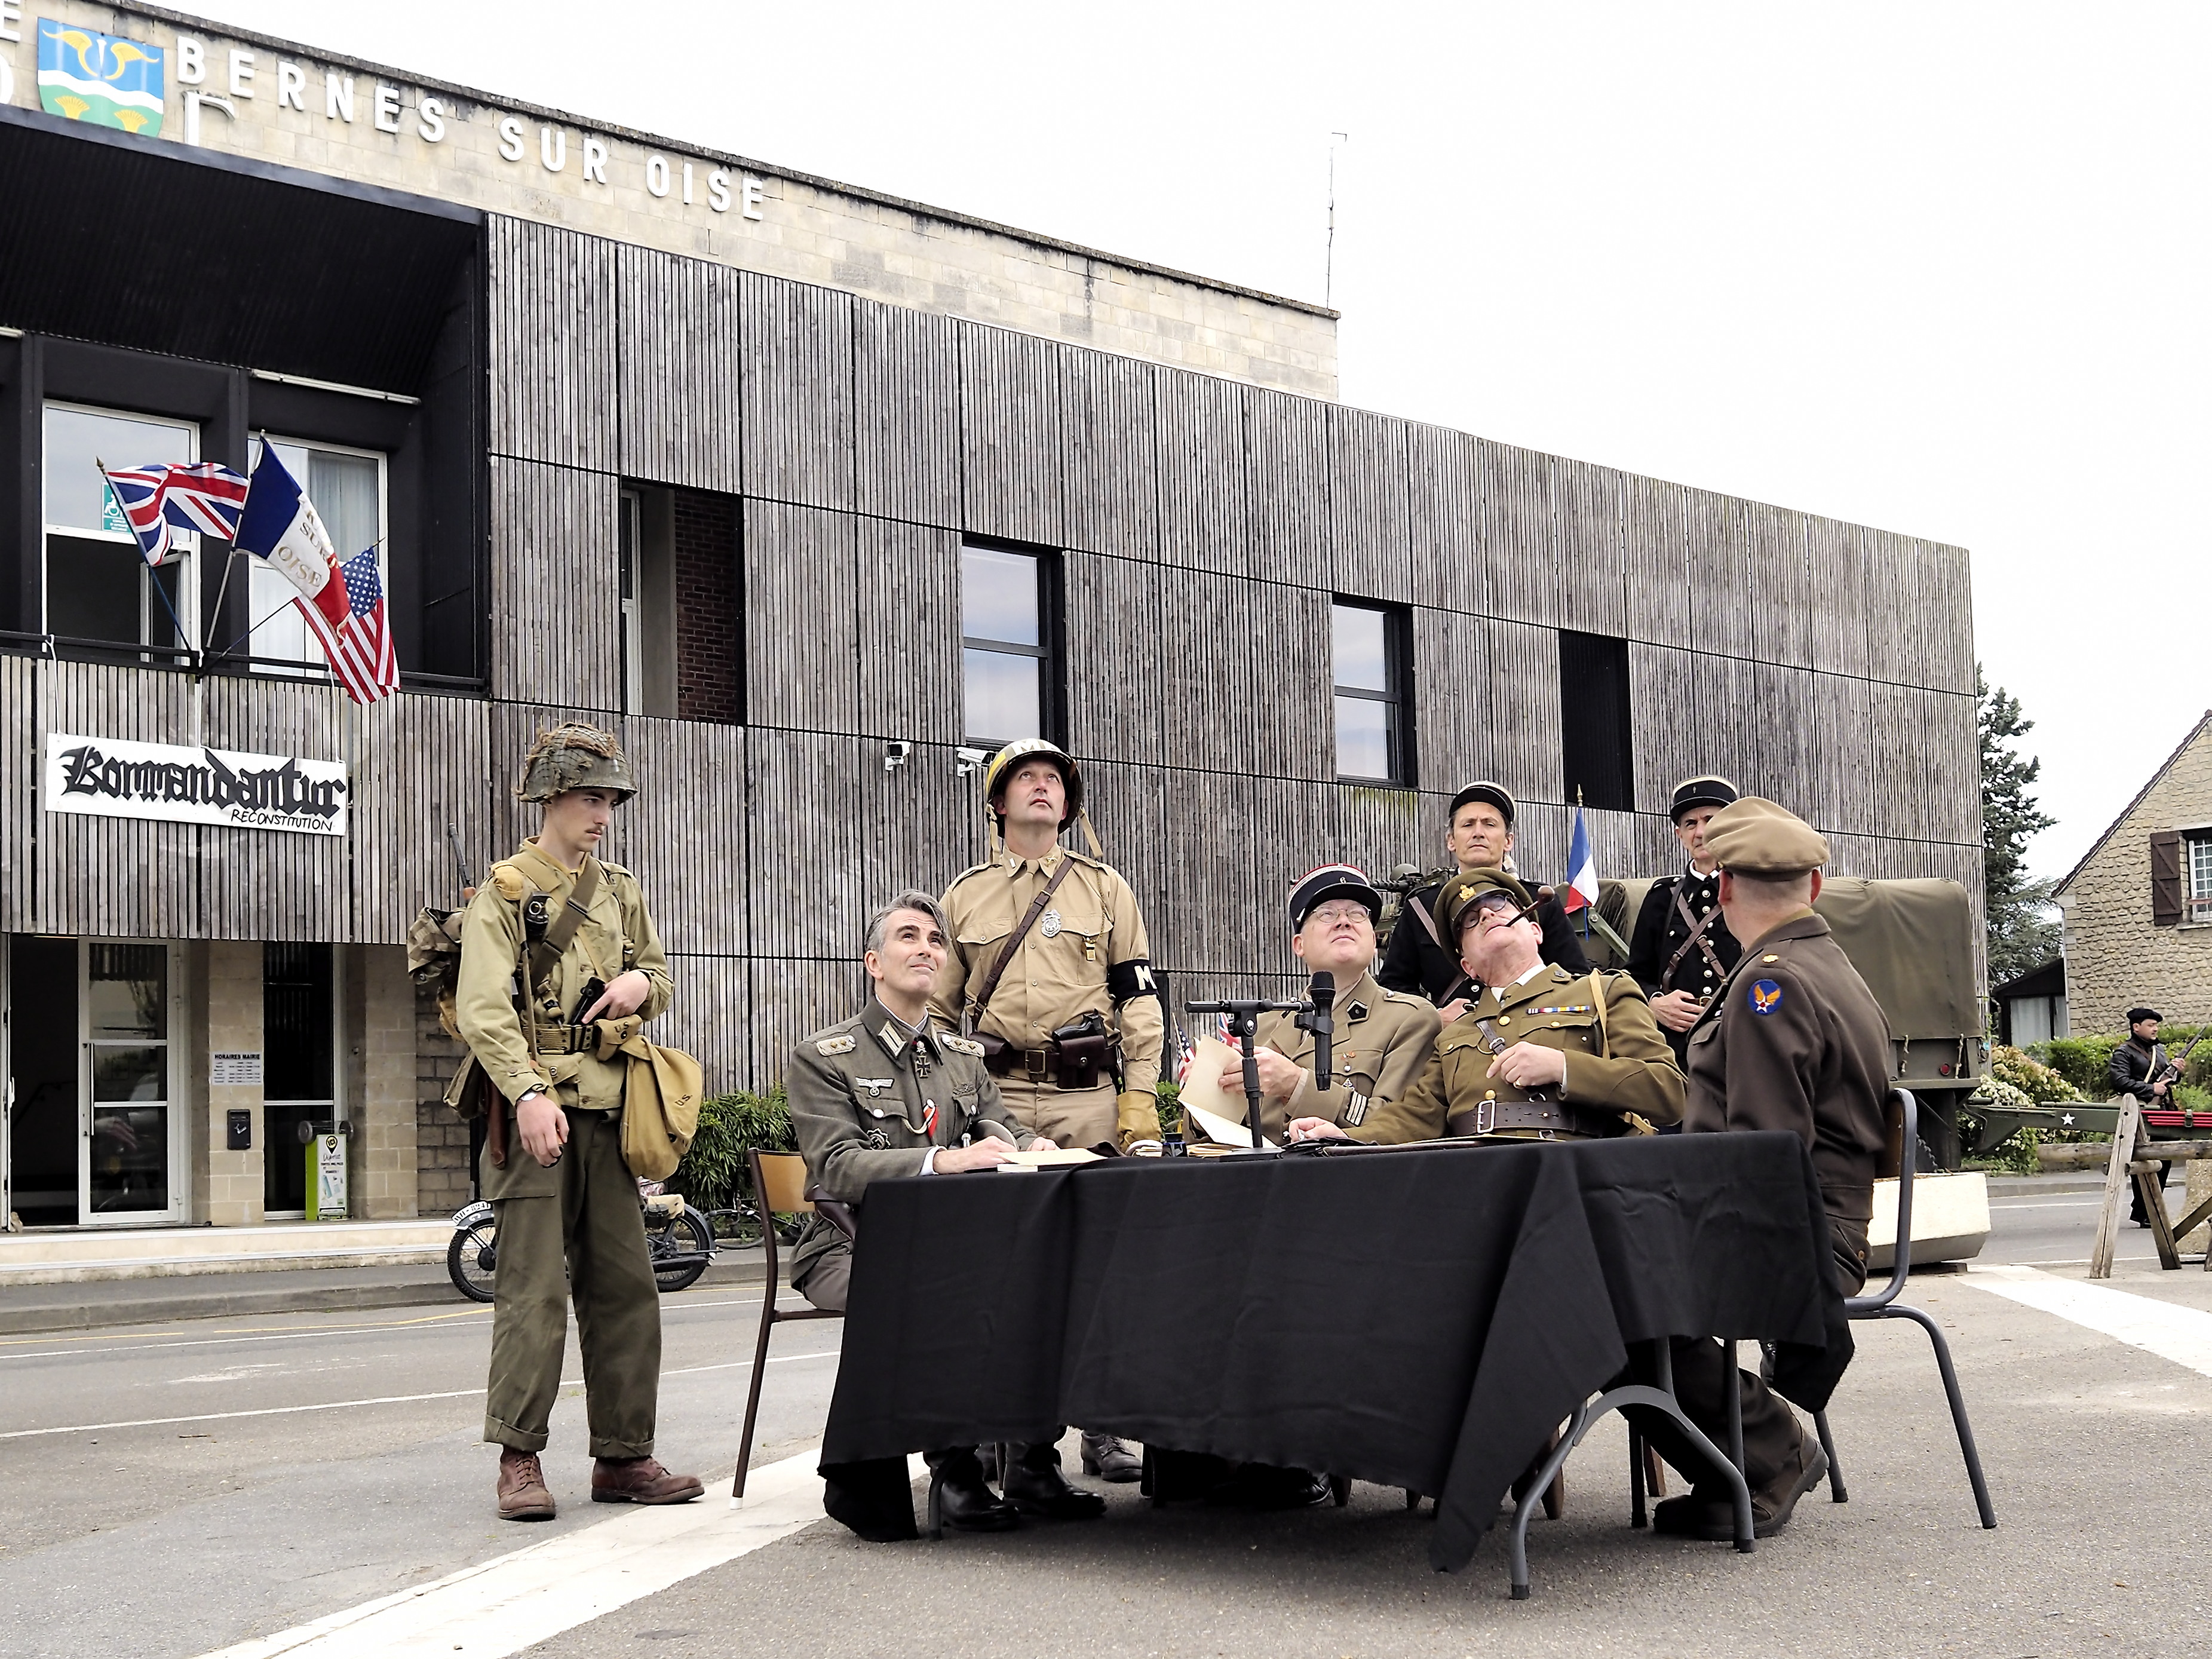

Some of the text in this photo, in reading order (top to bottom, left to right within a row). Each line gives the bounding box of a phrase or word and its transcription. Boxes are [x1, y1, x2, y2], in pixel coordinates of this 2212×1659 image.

[177, 36, 445, 142] BERNES
[498, 117, 608, 184] SUR
[646, 155, 763, 220] OISE
[278, 545, 323, 587] OISE
[58, 745, 346, 818] Kommandantur
[231, 809, 333, 831] RECONSTITUTION
[1134, 965, 1157, 990] M
